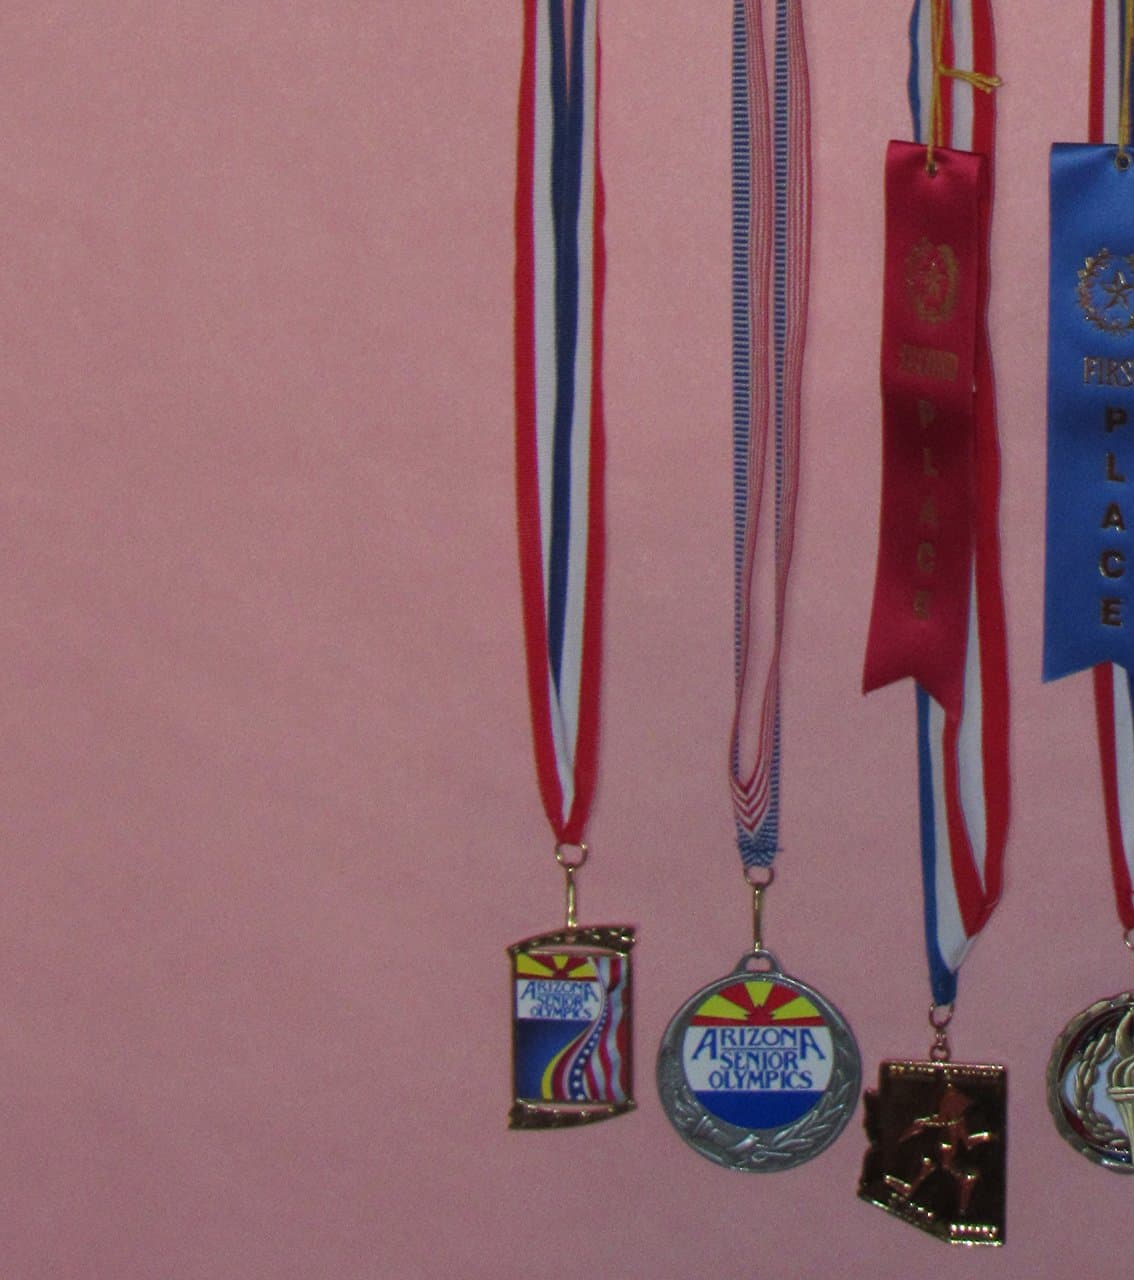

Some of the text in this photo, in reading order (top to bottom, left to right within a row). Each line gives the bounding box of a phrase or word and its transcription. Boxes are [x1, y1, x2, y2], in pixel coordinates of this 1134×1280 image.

[1097, 406, 1129, 627] PLACE
[520, 980, 599, 1002] ARIZONA
[691, 1028, 826, 1061] ARIZONA
[719, 1050, 799, 1071] SENIOR
[708, 1069, 813, 1089] OLYMPICS
